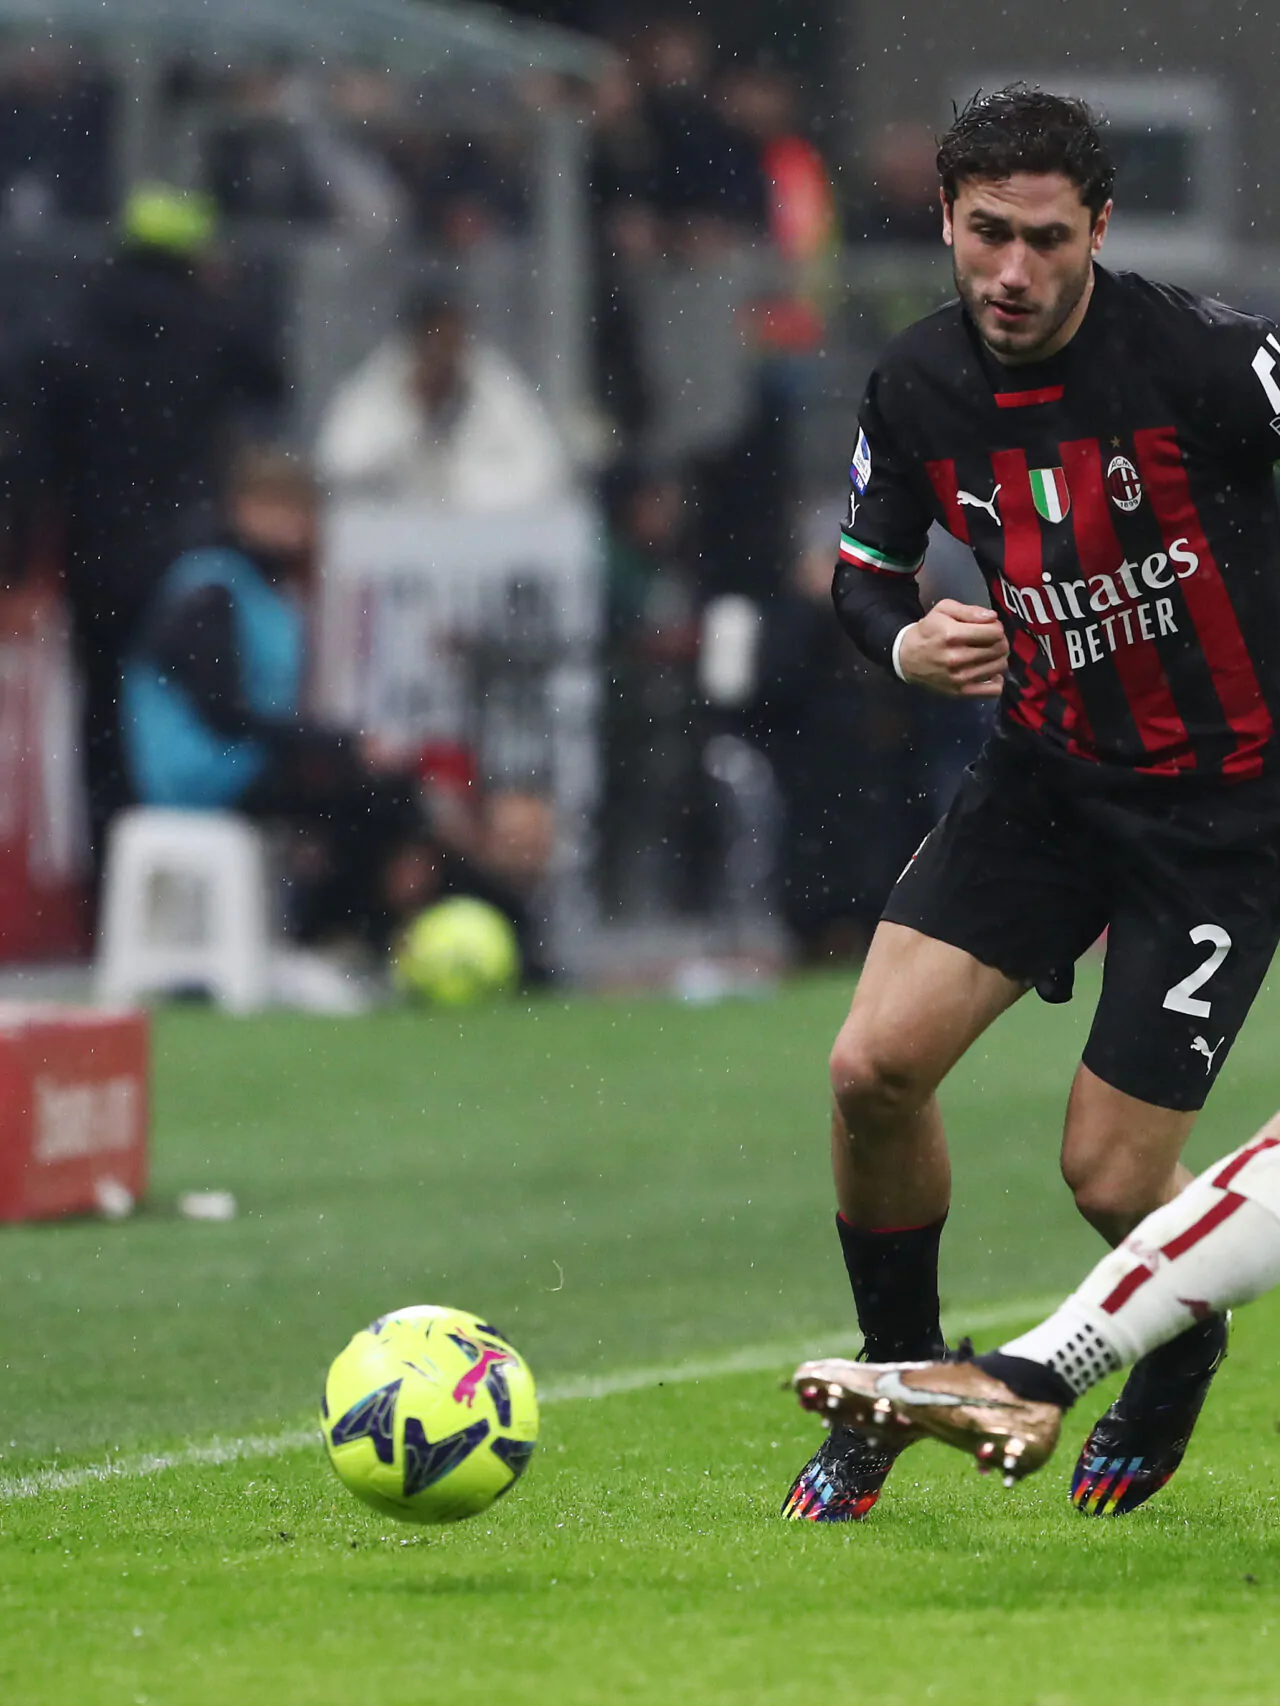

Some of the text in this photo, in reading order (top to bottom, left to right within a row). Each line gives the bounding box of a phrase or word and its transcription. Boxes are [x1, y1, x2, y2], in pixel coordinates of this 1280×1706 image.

[1119, 499, 1139, 508] 1899
[1064, 597, 1179, 670] BETTER
[1162, 923, 1232, 1018] 2
